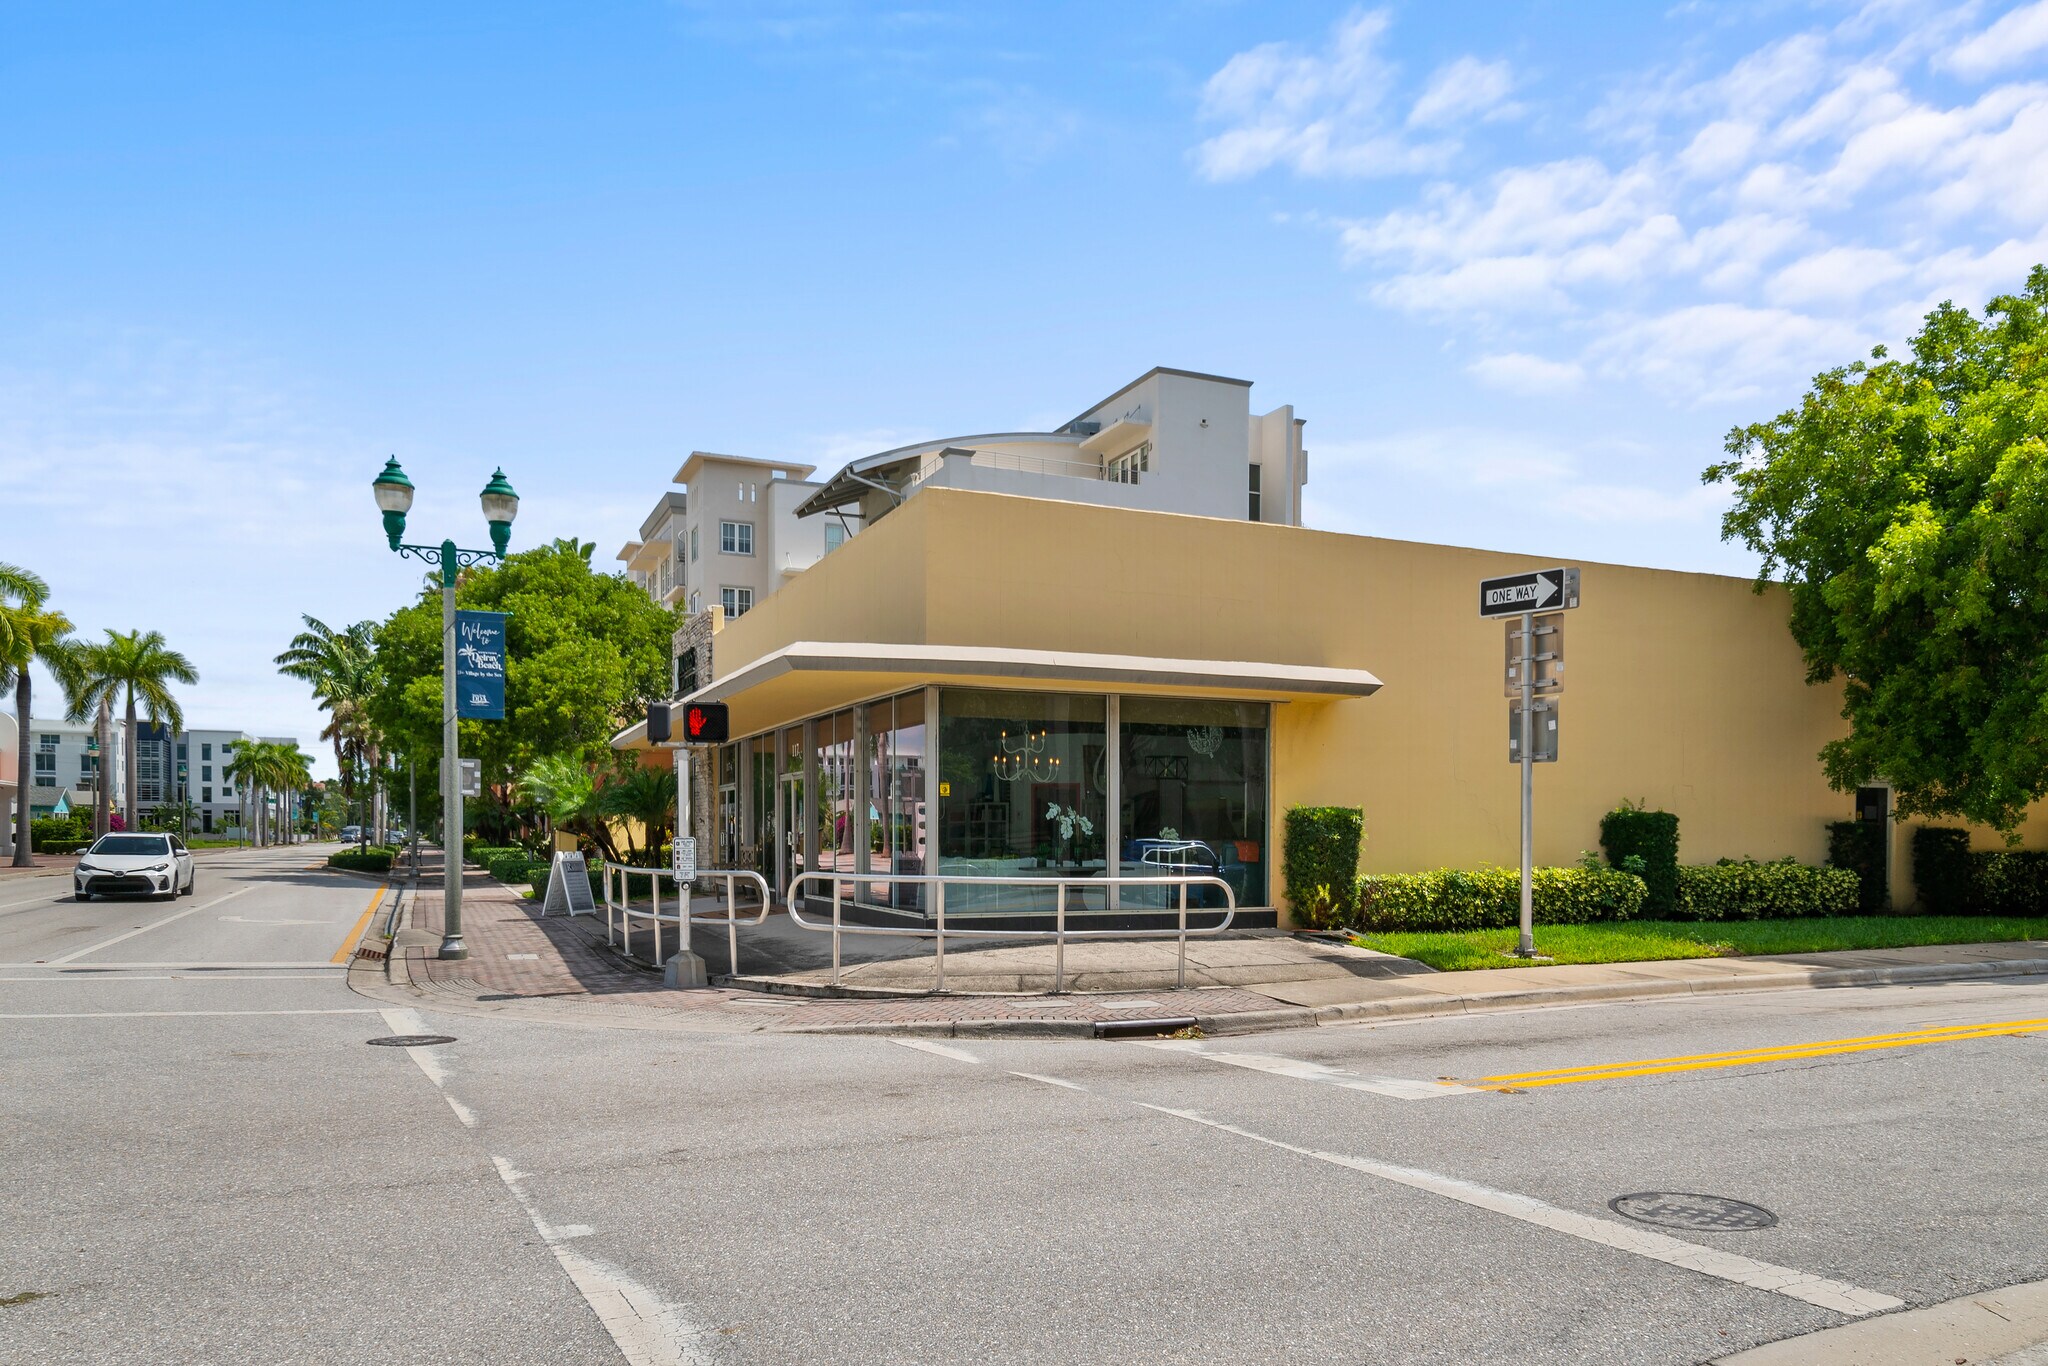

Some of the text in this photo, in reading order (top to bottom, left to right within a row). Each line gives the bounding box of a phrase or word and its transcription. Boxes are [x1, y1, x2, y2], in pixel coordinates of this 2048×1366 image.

[1492, 585, 1537, 603] ONE WAY
[462, 622, 500, 641] Welcome
[481, 637, 491, 645] to
[472, 652, 501, 663] Delray
[478, 660, 503, 671] Beach
